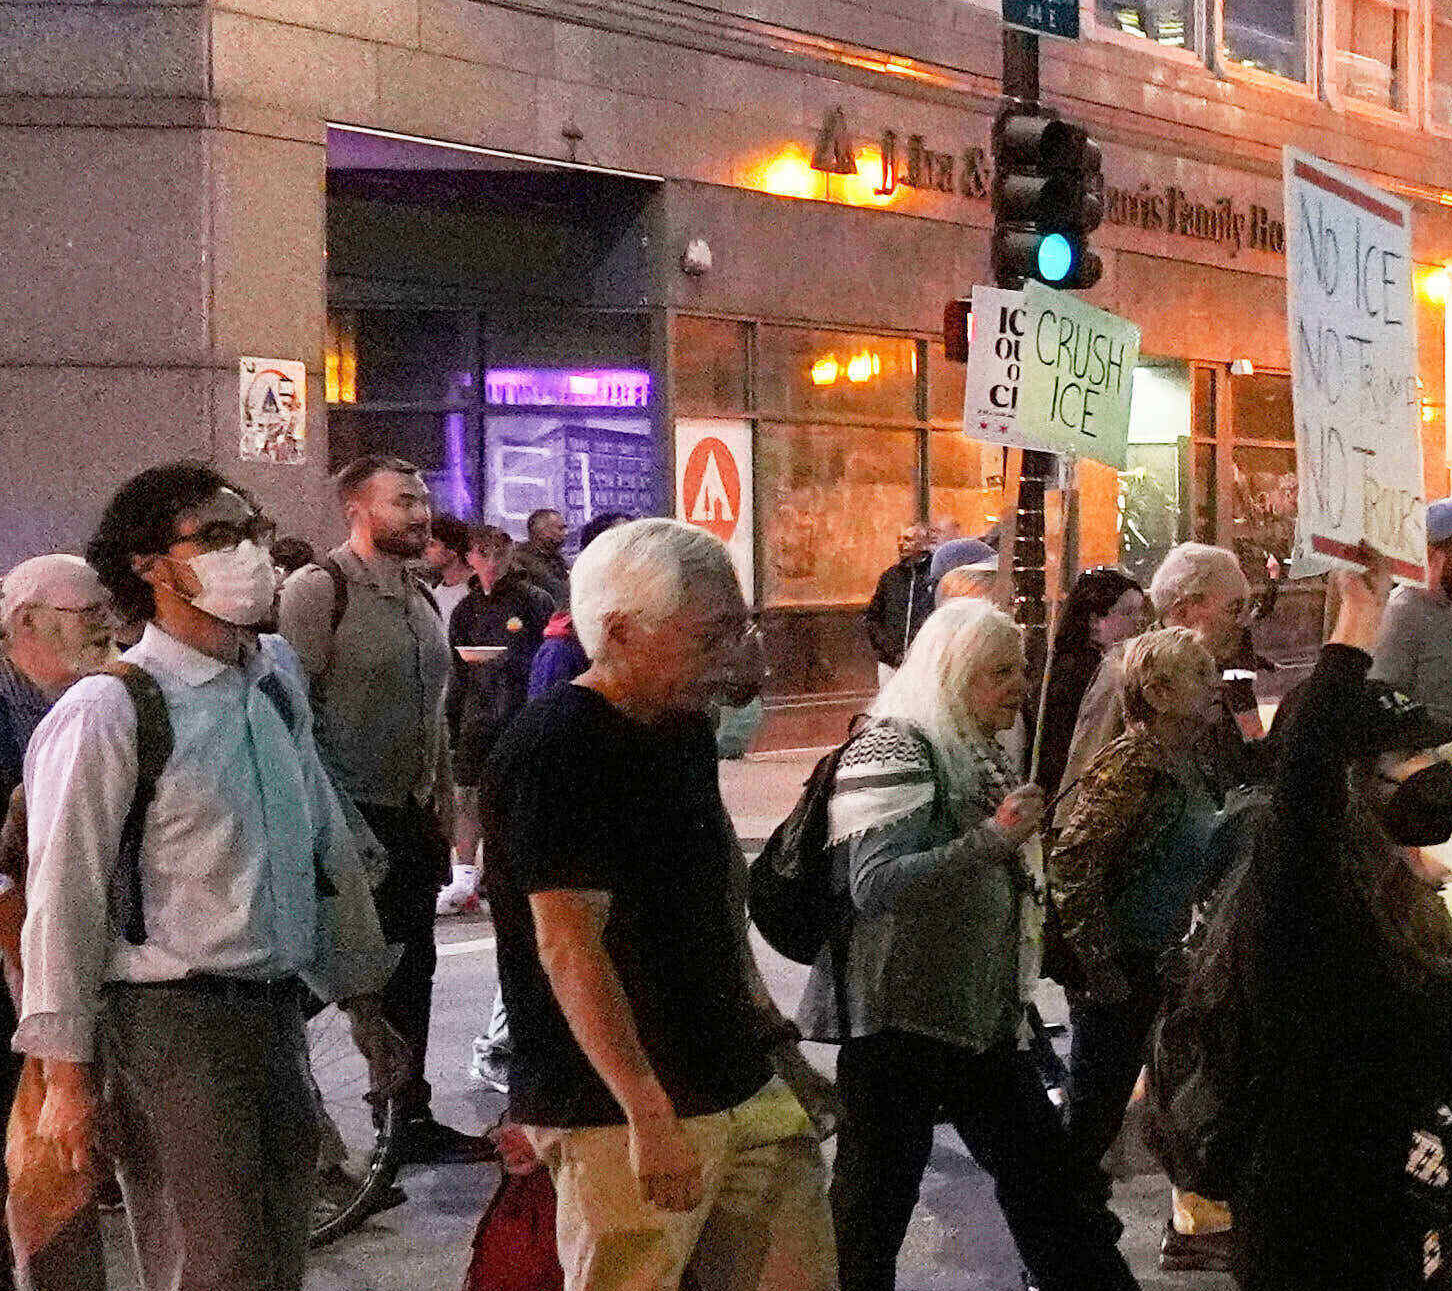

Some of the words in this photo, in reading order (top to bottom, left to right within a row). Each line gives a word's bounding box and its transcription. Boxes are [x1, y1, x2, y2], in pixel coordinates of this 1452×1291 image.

[1163, 185, 1247, 258] Family
[1249, 202, 1285, 256] Ho
[1355, 217, 1403, 325] ICE
[1036, 309, 1126, 395] CRUSH
[1050, 375, 1101, 438] ICE
